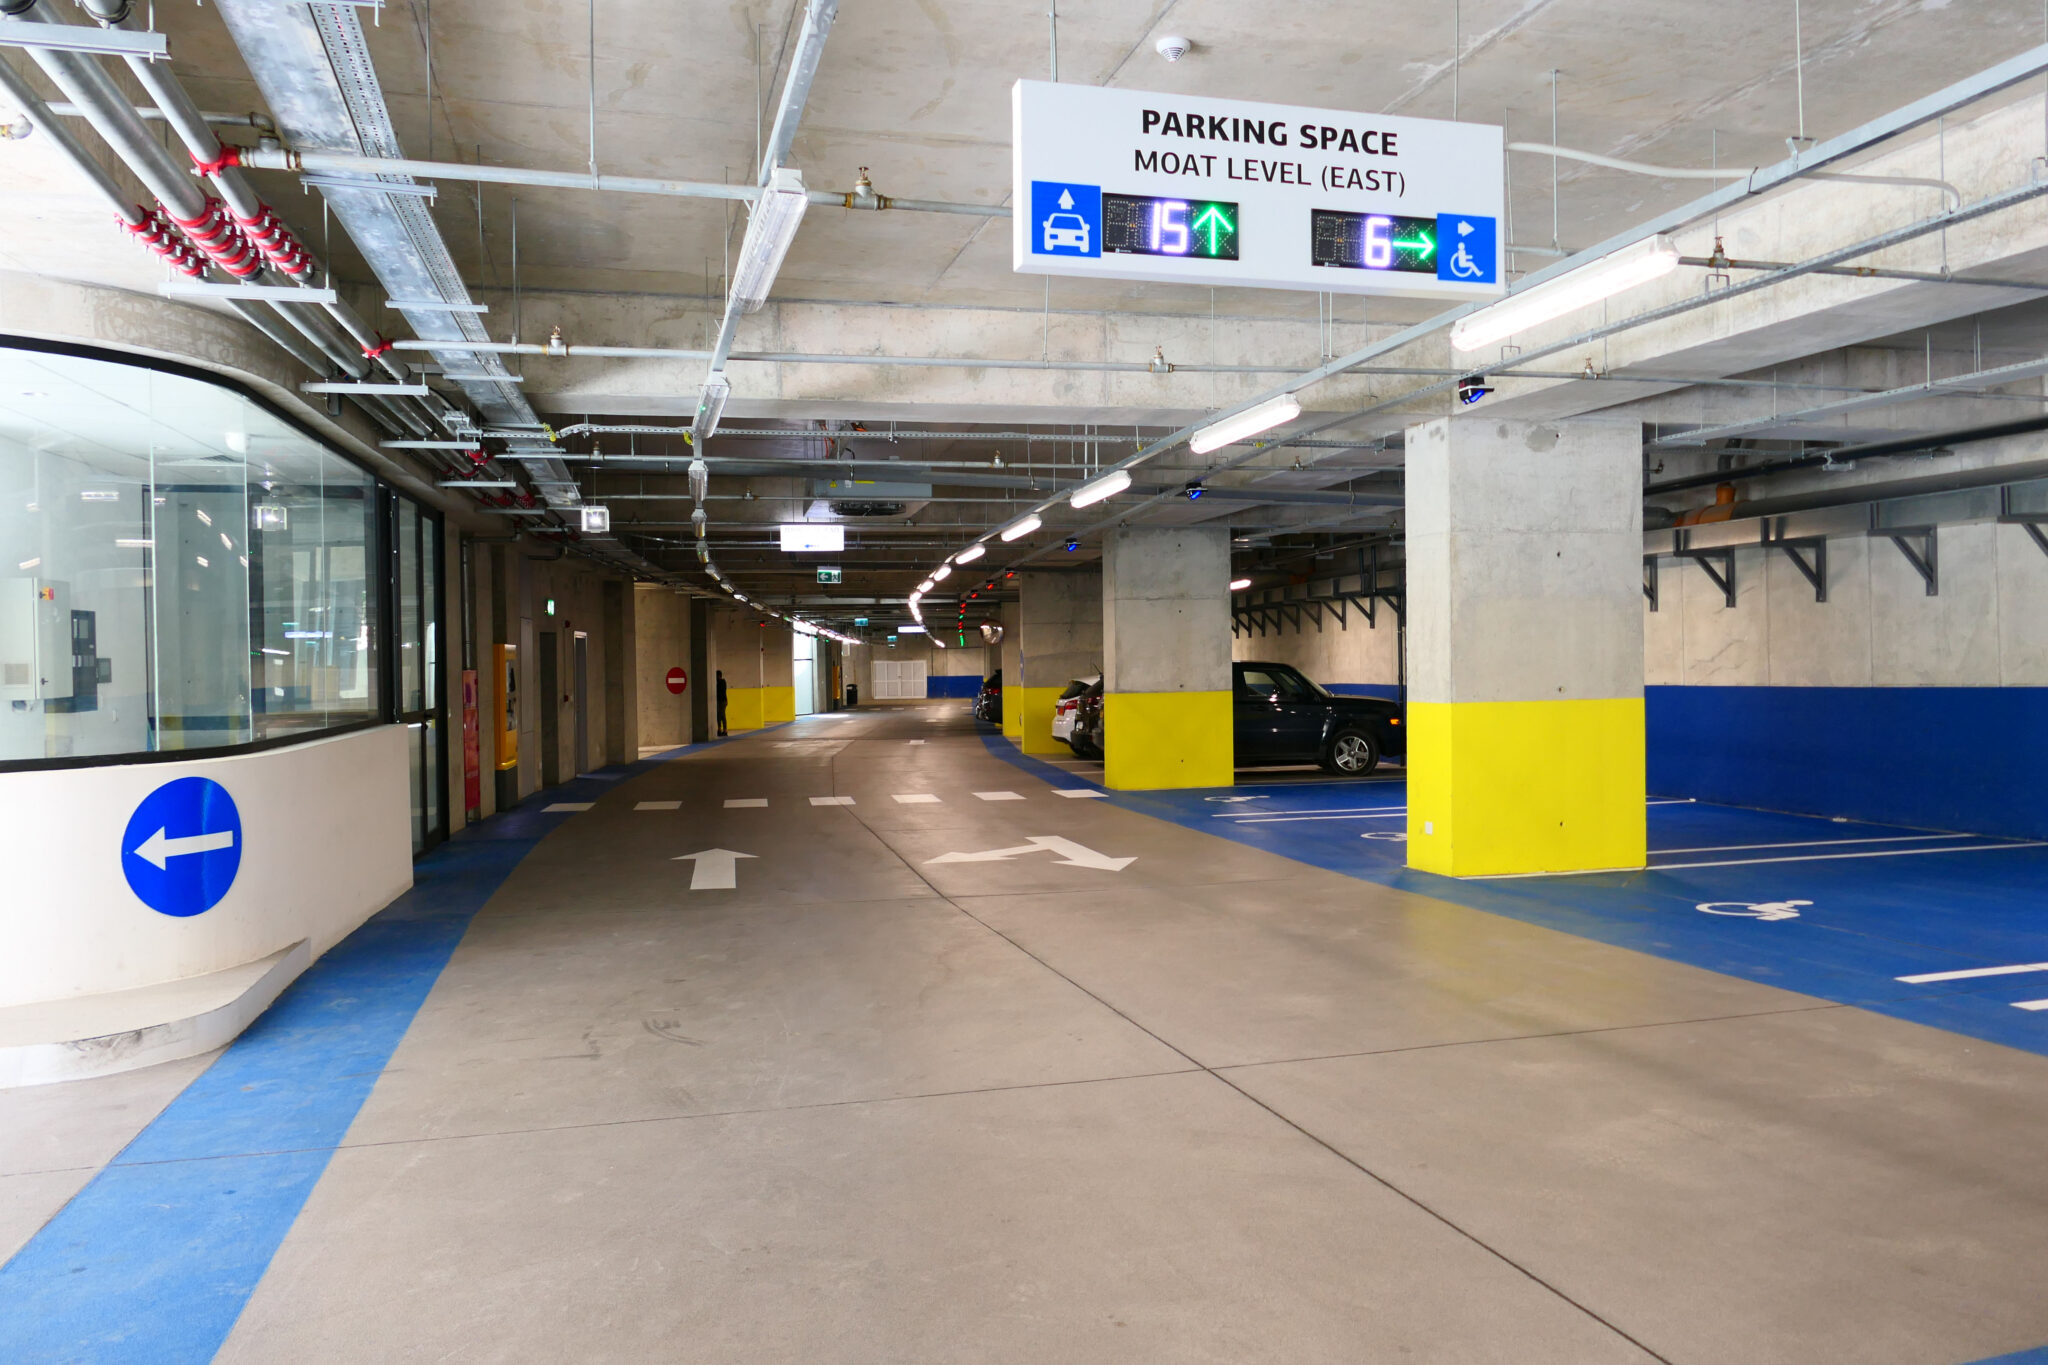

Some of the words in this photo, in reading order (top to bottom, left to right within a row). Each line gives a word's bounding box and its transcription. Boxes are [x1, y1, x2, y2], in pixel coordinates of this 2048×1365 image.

[1141, 109, 1288, 146] PARKING
[1299, 124, 1399, 157] SPACE
[1134, 149, 1217, 178] MOAT
[1227, 157, 1312, 186] LEVEL
[1321, 165, 1406, 198] (EAST)
[1150, 202, 1189, 253] 15
[1364, 217, 1392, 268] 6
